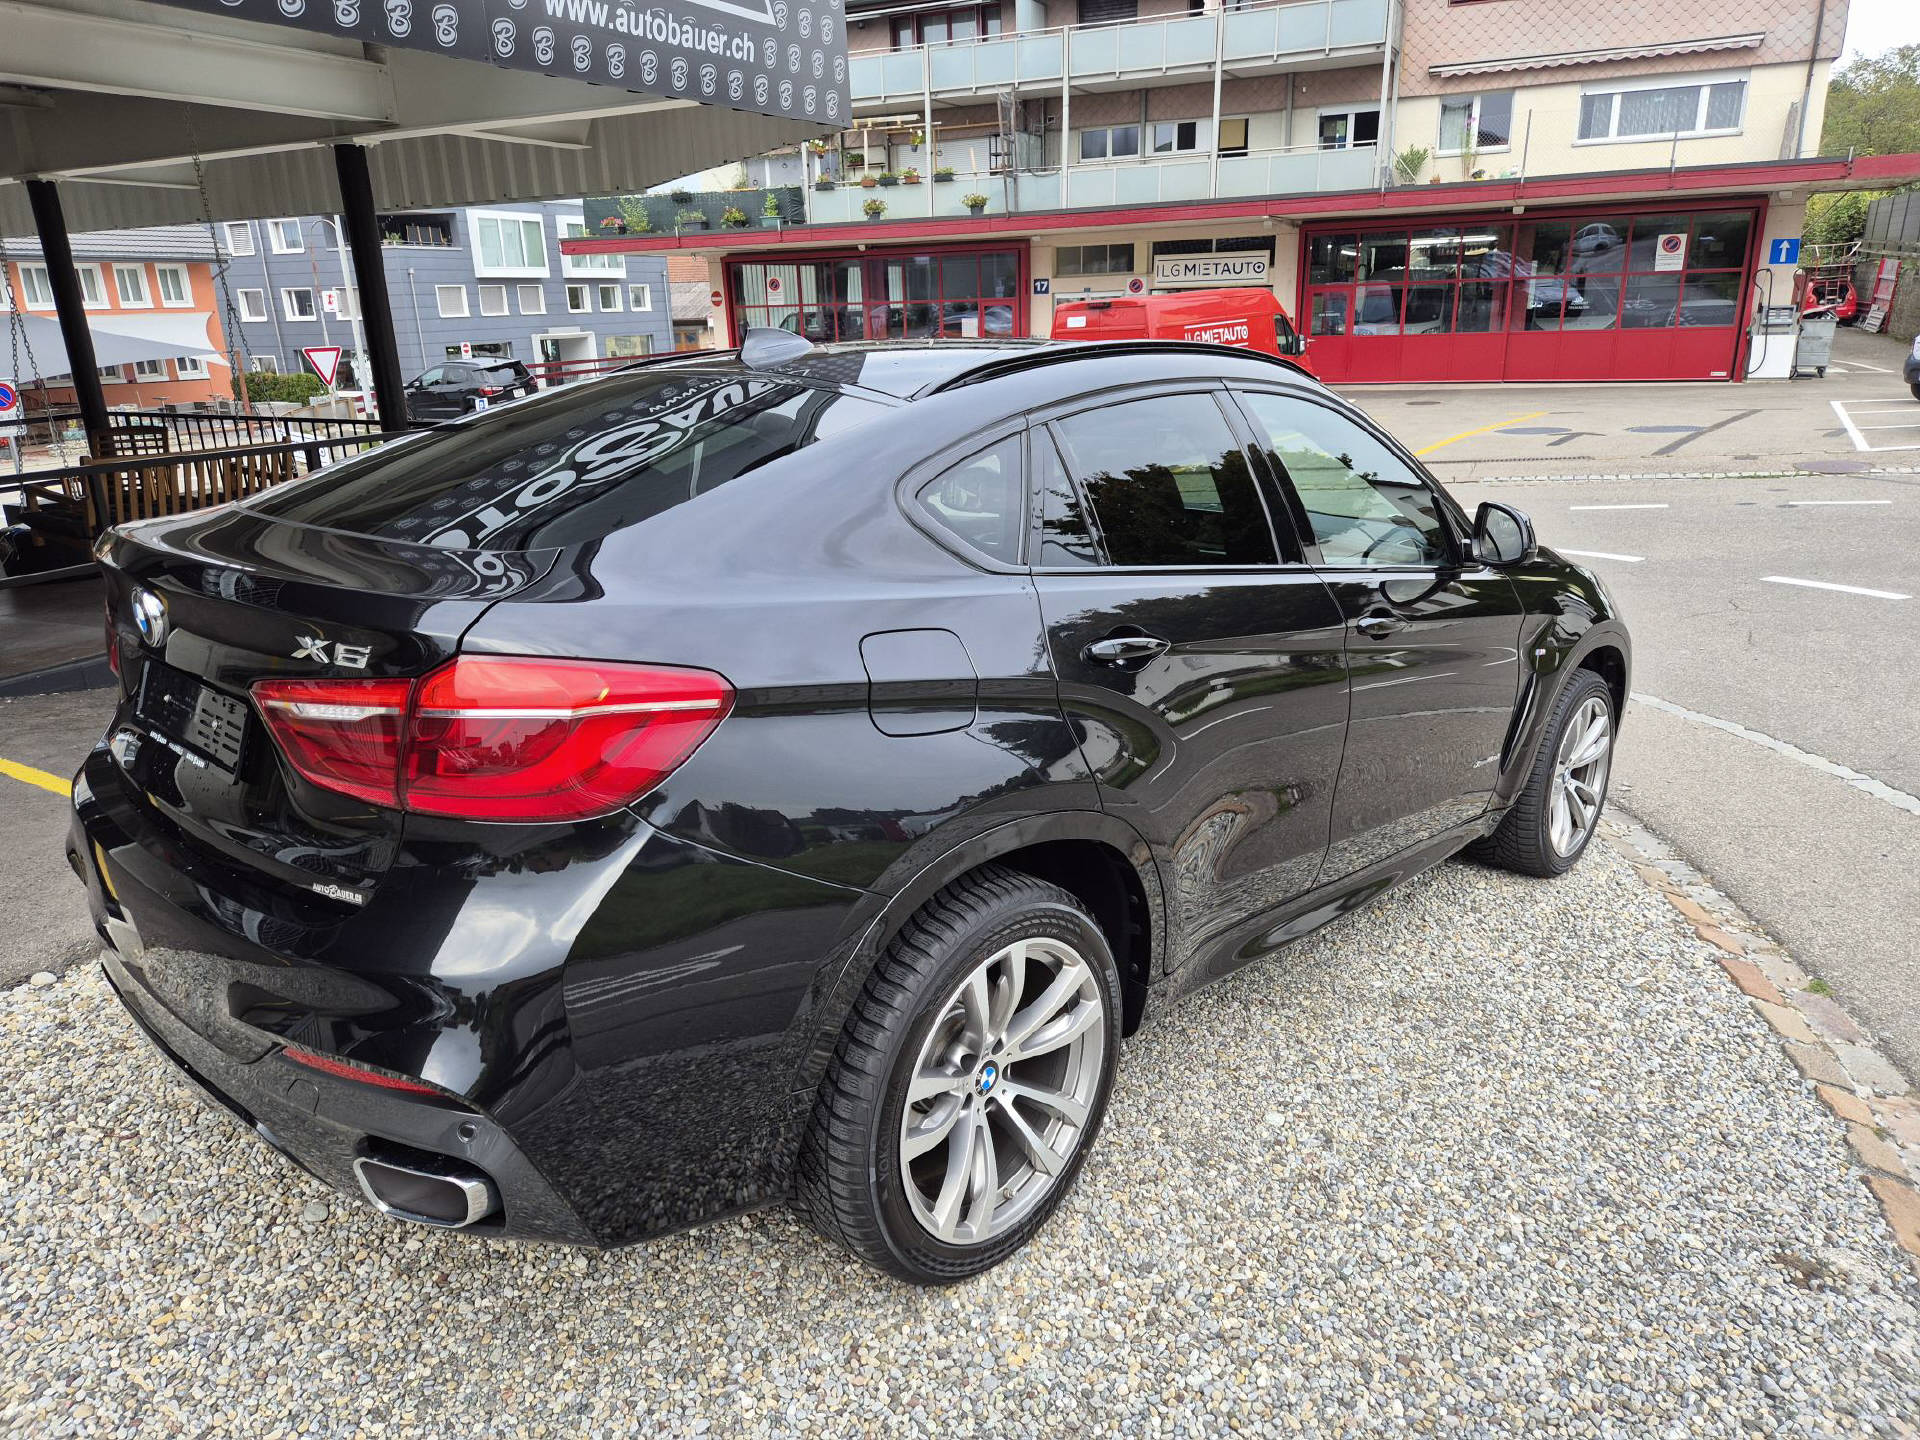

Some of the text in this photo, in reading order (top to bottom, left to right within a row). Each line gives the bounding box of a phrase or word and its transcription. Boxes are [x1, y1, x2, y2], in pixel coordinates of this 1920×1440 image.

[544, 0, 755, 63] www.autobauer.ch
[1156, 261, 1265, 278] ILG MIETAUTO
[1035, 281, 1048, 292] 17
[291, 635, 372, 669] X6
